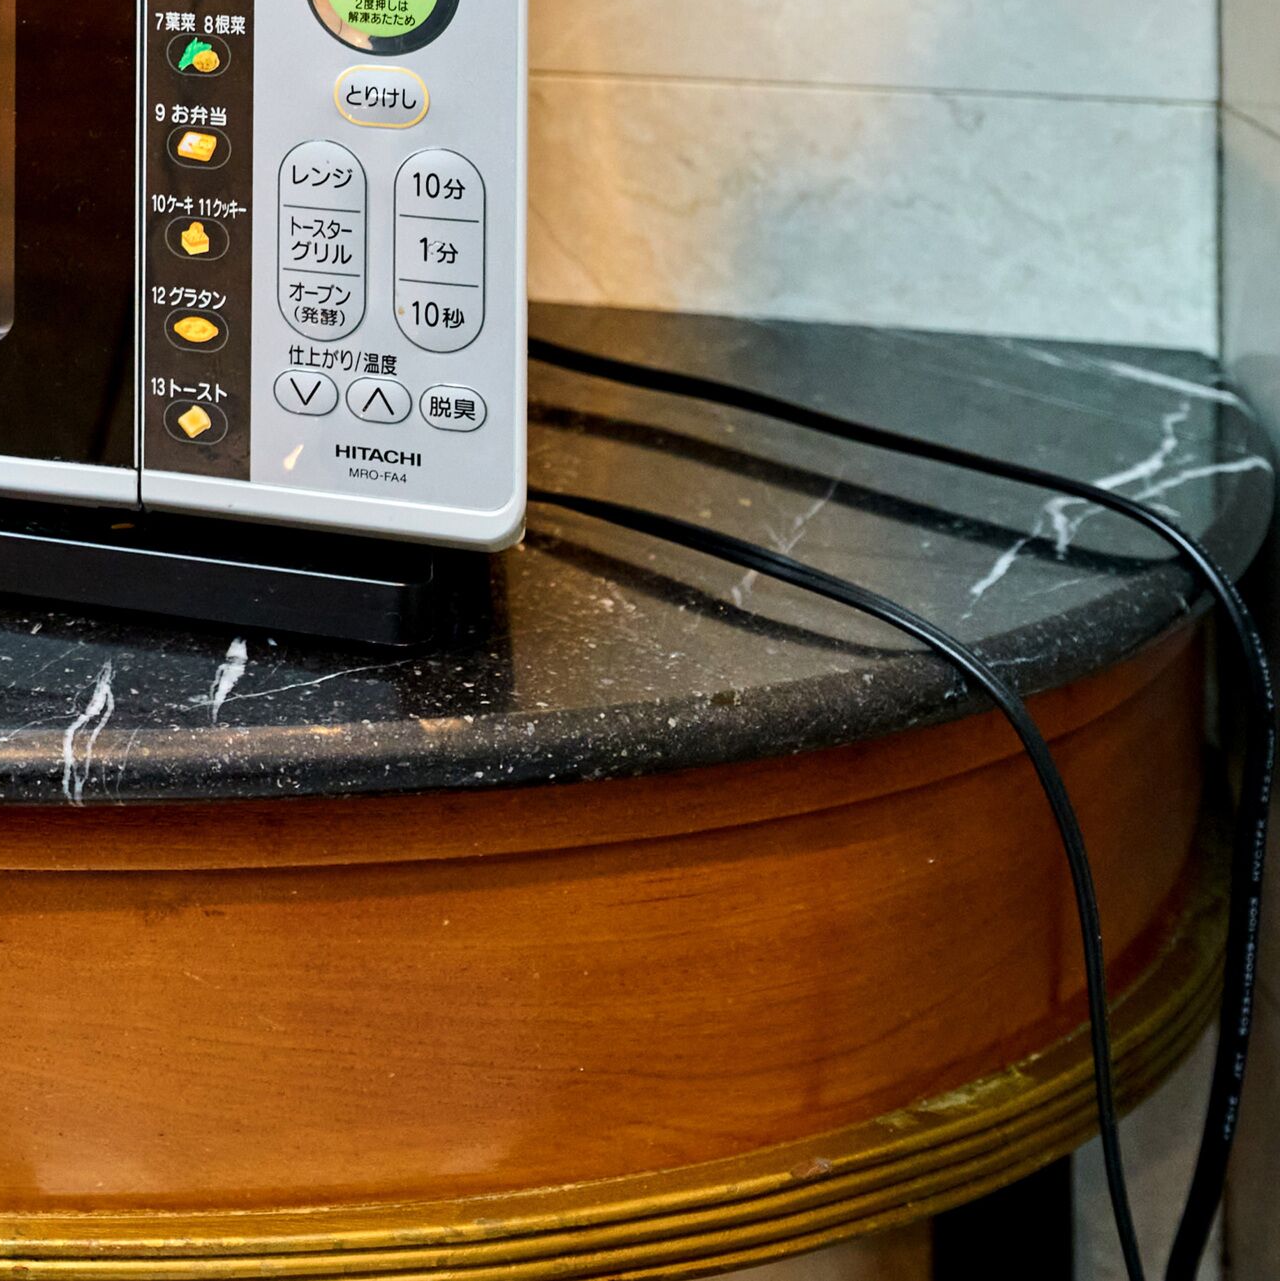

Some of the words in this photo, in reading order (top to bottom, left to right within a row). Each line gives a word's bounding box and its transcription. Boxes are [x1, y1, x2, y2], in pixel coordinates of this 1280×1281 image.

[348, 9, 416, 27] 解凍あたため
[345, 83, 418, 111] とりけし
[292, 164, 354, 188] レンジ
[413, 171, 466, 200] 10分
[290, 217, 354, 239] トースター
[291, 240, 353, 265] グリル
[419, 236, 459, 264] 1分
[289, 281, 352, 306] オーブン
[412, 300, 466, 329] 10秒
[288, 344, 399, 377] 仕上がり/温度
[429, 395, 477, 421] 脱臭
[336, 443, 423, 467] HITACHI
[348, 467, 408, 484] MRO-FA4
